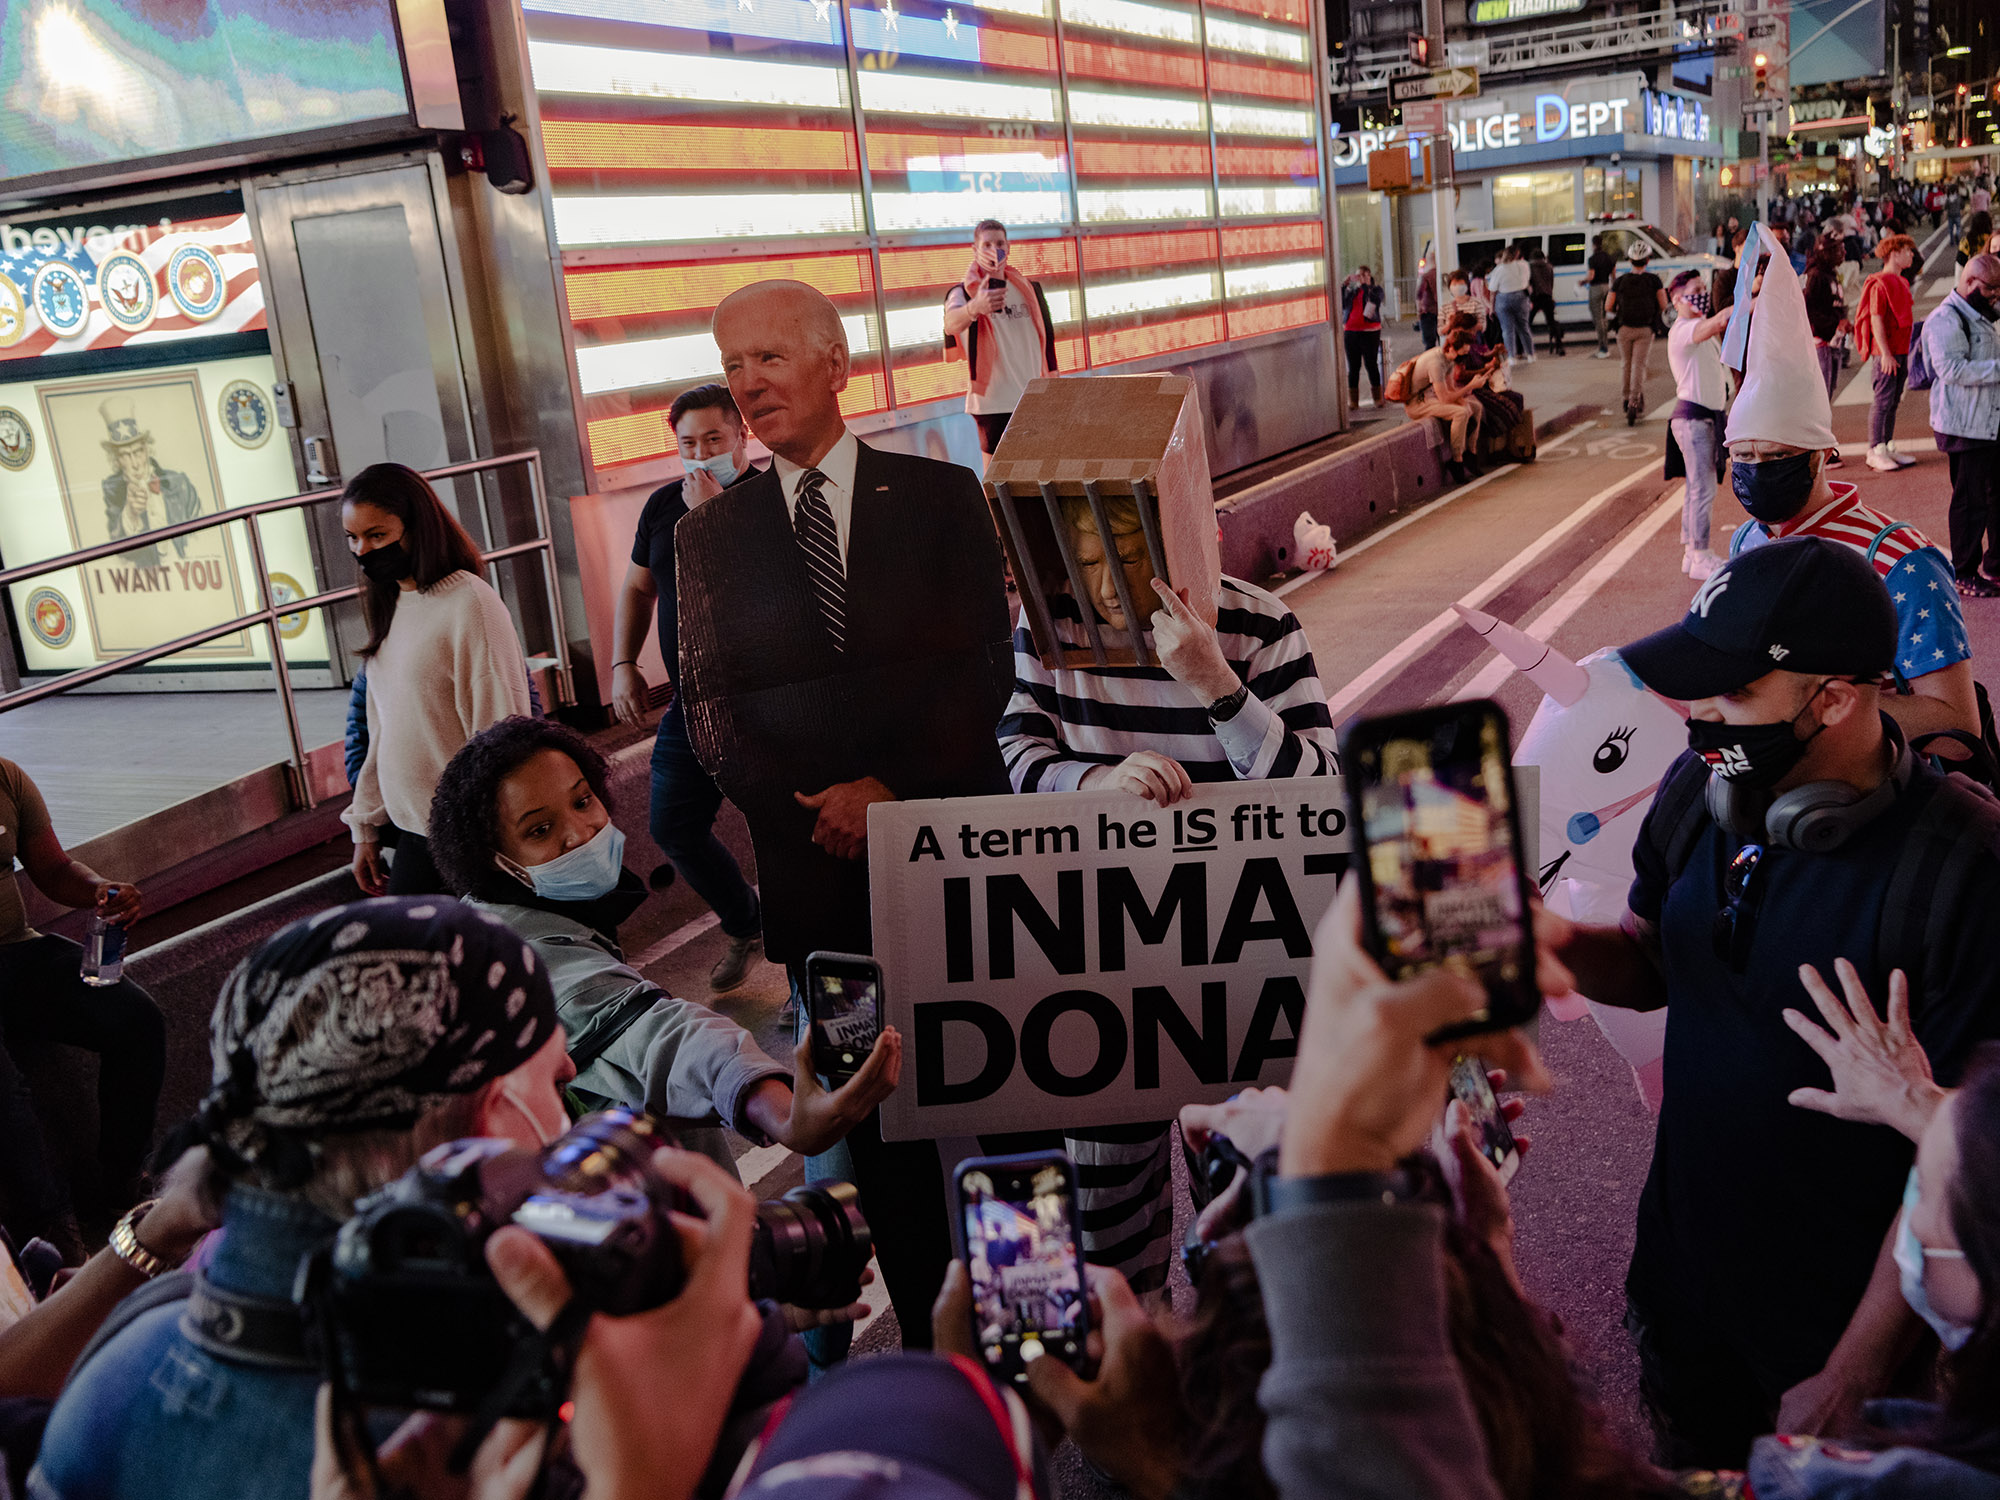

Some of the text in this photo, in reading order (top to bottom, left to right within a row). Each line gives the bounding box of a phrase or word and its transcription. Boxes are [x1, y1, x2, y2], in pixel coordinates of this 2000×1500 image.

[1401, 77, 1464, 96] ONE WAY
[1330, 121, 1397, 166] ORK
[1408, 113, 1522, 159] LICE
[1535, 93, 1630, 143] DEPT
[94, 559, 223, 594] I WANT YOU
[908, 803, 1347, 863] A term he IS fit to
